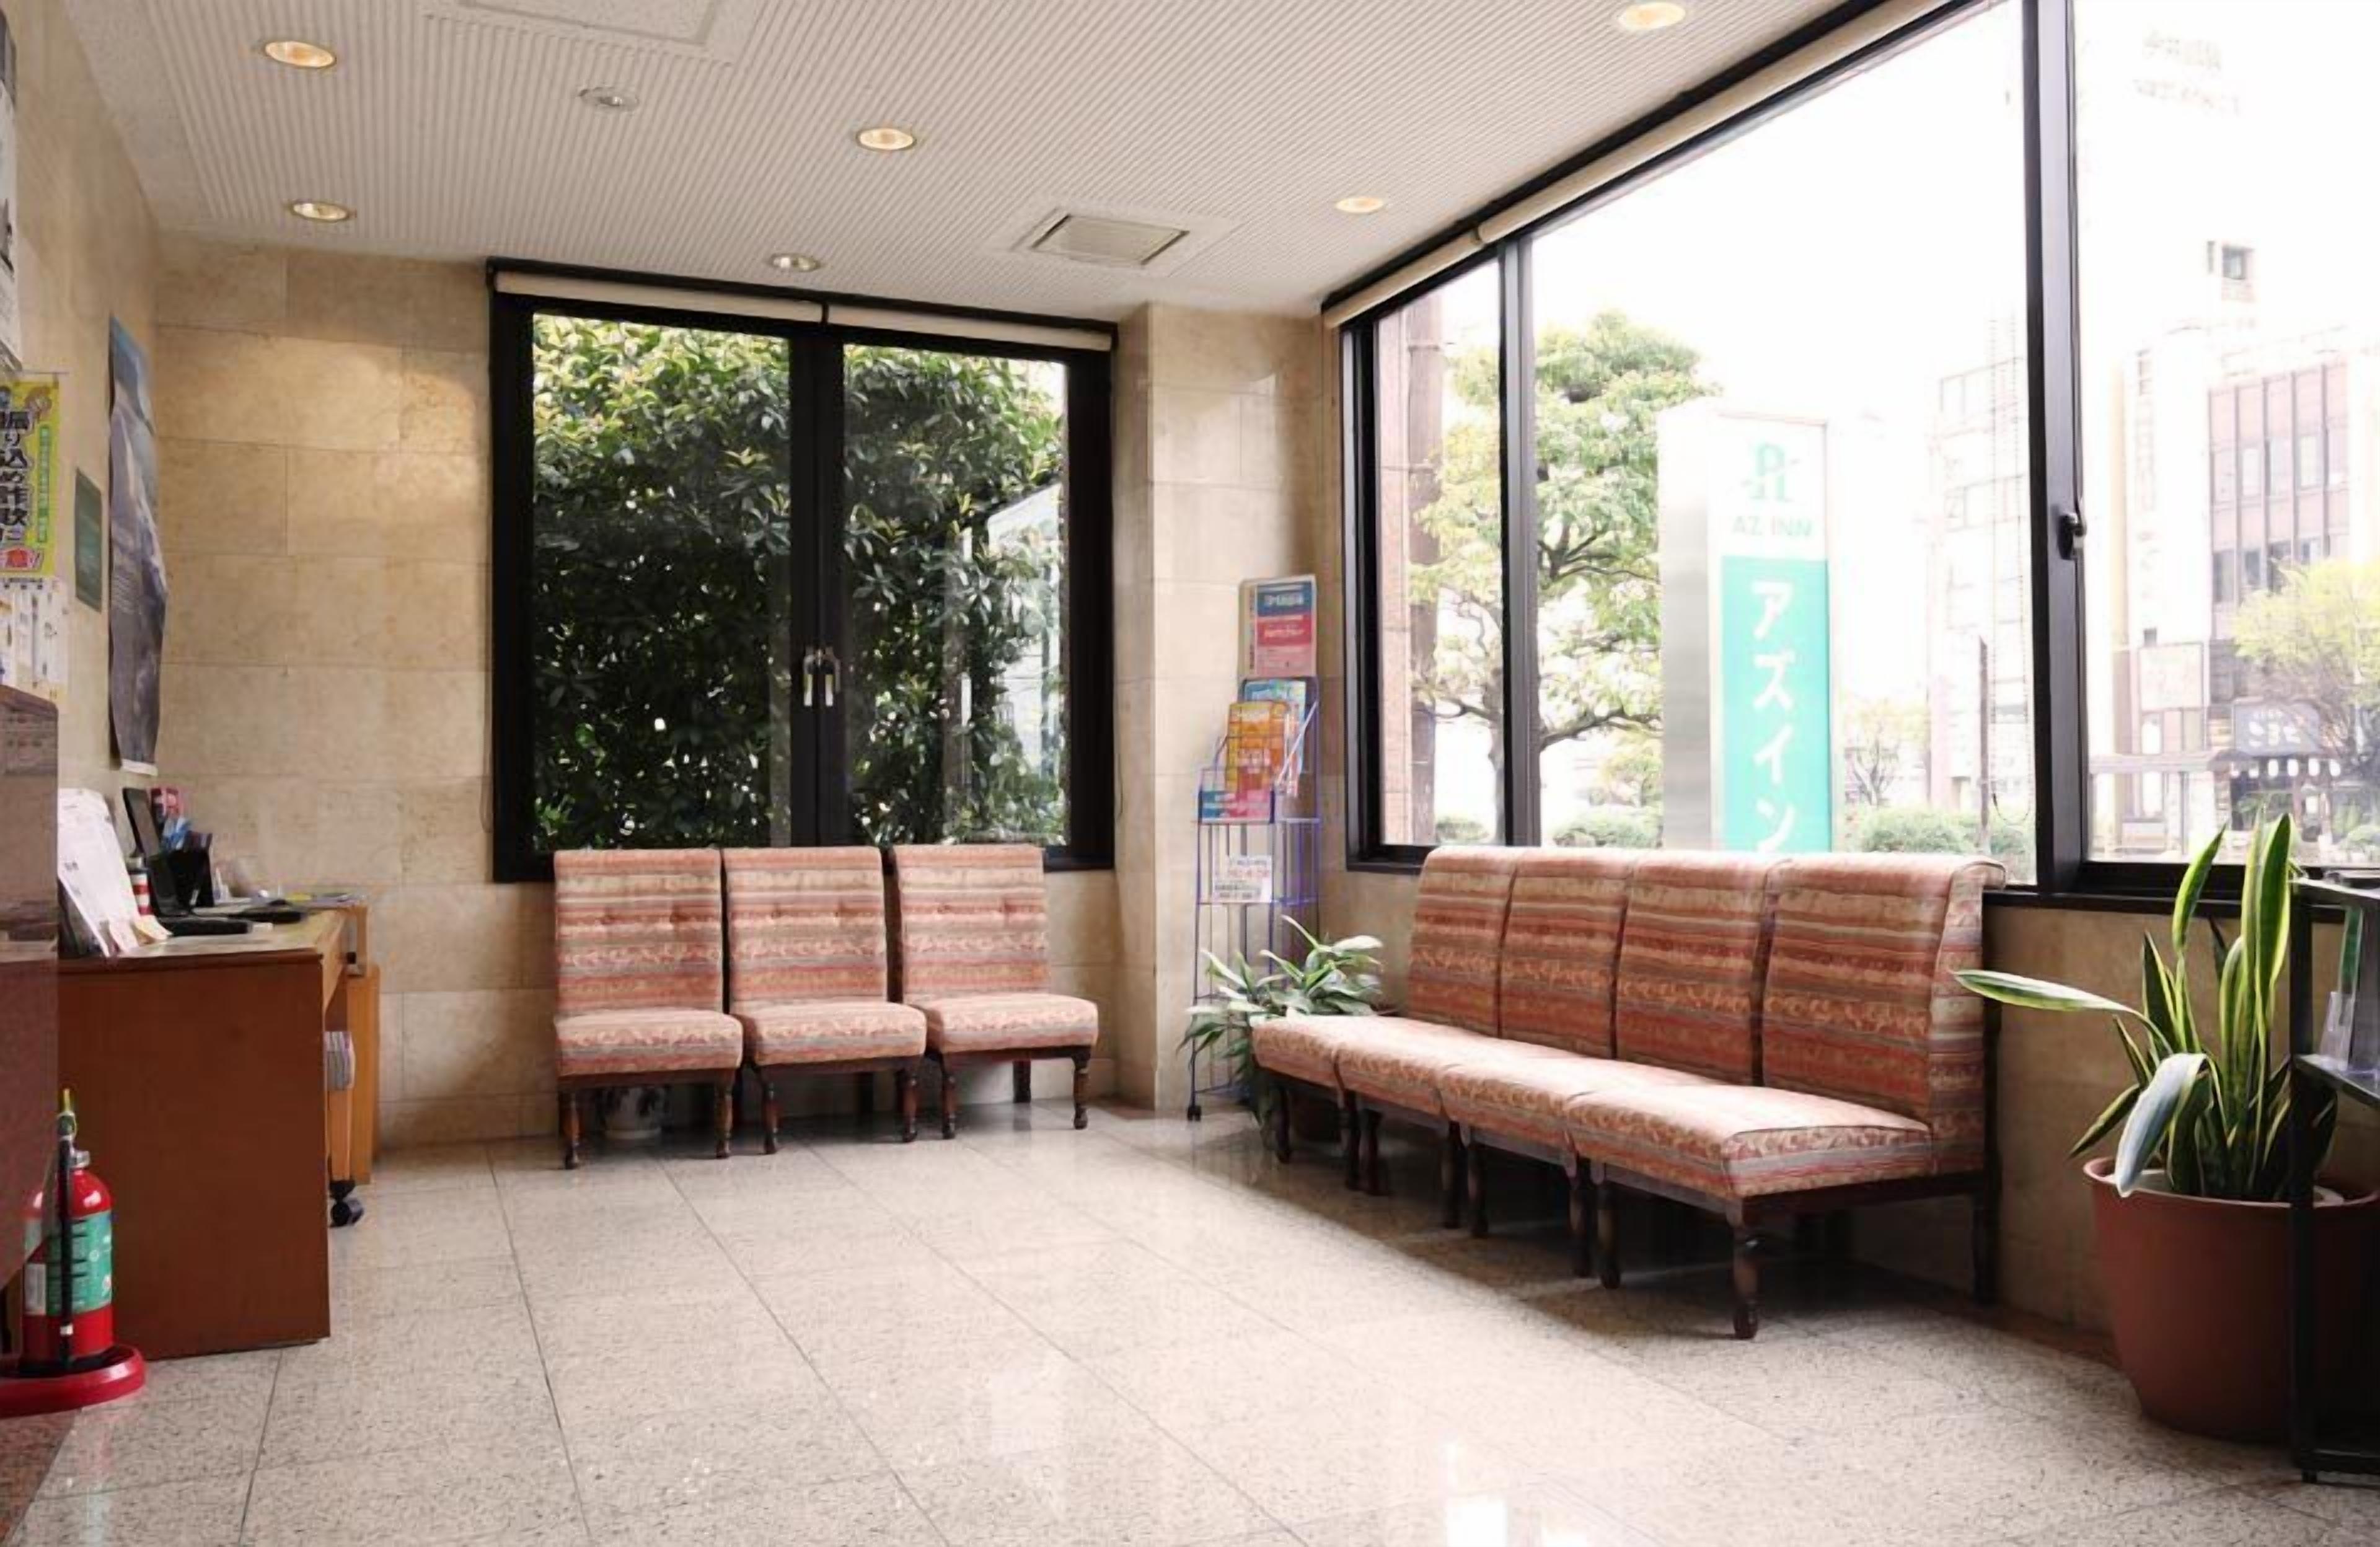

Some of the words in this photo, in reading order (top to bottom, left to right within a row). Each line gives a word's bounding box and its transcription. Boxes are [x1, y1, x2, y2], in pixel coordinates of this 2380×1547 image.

[1733, 515, 1764, 536] AZ
[1771, 516, 1813, 537] INN
[1752, 581, 1795, 852] アズイン
